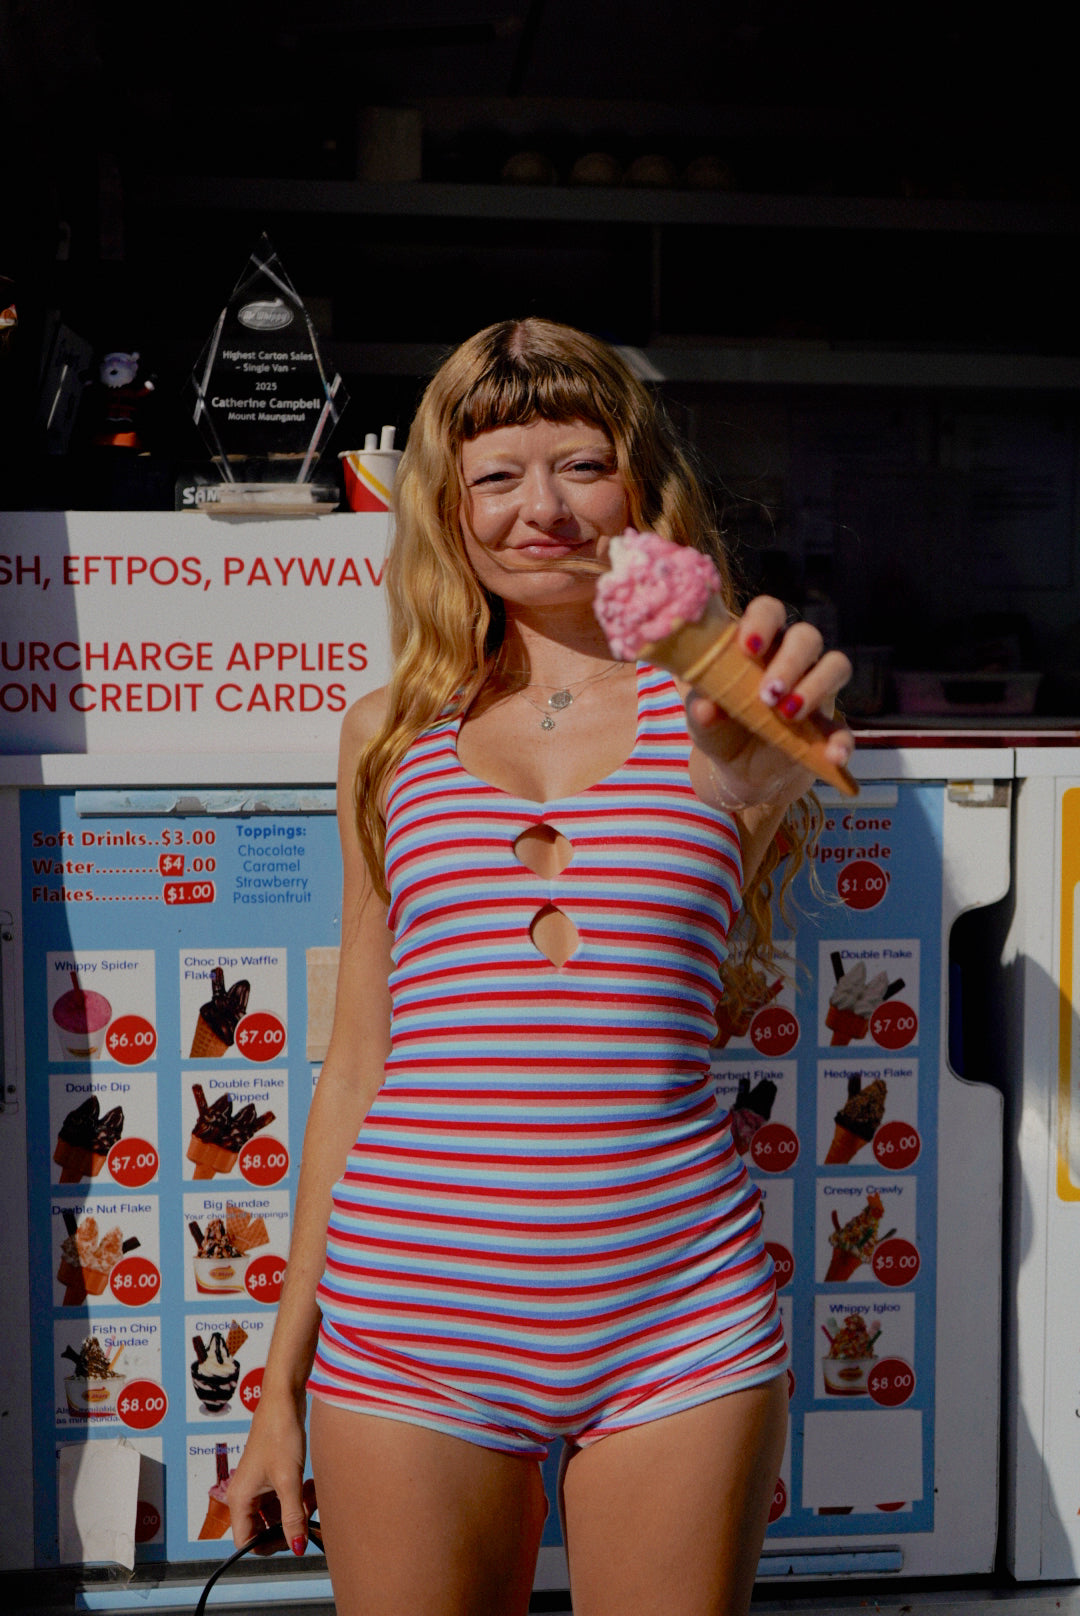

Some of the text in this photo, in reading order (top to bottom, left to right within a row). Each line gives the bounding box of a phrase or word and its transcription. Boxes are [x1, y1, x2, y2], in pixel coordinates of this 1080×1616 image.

[222, 351, 314, 361] Highest Carton Sales
[243, 363, 270, 373] Single
[271, 364, 289, 373] Van
[255, 381, 278, 391] 2025
[211, 397, 321, 411] Catherine Campbell
[228, 412, 306, 423] Mount Maunganui
[63, 555, 212, 592] EFTPOS,
[1, 641, 368, 672] URCHARGE APPLIES
[1, 682, 348, 713] ON CREDIT CARDS
[843, 815, 892, 831] Cone
[236, 824, 307, 839] Toppings:
[32, 830, 75, 848] Soft
[238, 844, 305, 857] Chocolate
[243, 859, 300, 872] Caramel
[235, 875, 309, 890] Strawberry
[841, 877, 883, 893] $1.00
[167, 884, 212, 904] $1.00
[233, 891, 312, 904] Passionfruit
[841, 949, 913, 960] Double Flake
[55, 960, 140, 972] Whippy Spider
[184, 956, 279, 968] Choc Dip Waffle
[873, 1016, 915, 1034] $7.00
[239, 1029, 284, 1047] $7.00
[754, 1022, 796, 1043] $8.00
[109, 1031, 154, 1050] $6.00
[754, 1070, 784, 1080] Flake
[884, 1068, 913, 1077] Flake
[65, 1082, 131, 1094] Double Dip
[209, 1077, 285, 1089] Double Flake
[228, 1092, 270, 1103] Dipped
[754, 1140, 796, 1156] $6.00
[876, 1135, 918, 1155] $6.00
[111, 1153, 156, 1174] $7.00
[242, 1153, 287, 1170] $8.00
[823, 1184, 904, 1196] Creepy Crawly
[96, 1204, 119, 1214] Nut
[121, 1203, 152, 1214] Flake
[203, 1199, 271, 1211] Big Sundae
[875, 1255, 918, 1271] $5.00
[113, 1272, 159, 1290] $8.00
[830, 1303, 901, 1315] Whippy Igloo
[92, 1323, 158, 1336] Fish n Chip
[241, 1320, 264, 1331] Cup
[104, 1337, 149, 1347] Sundae
[871, 1373, 912, 1391] $8.00
[120, 1396, 165, 1415] $8.00
